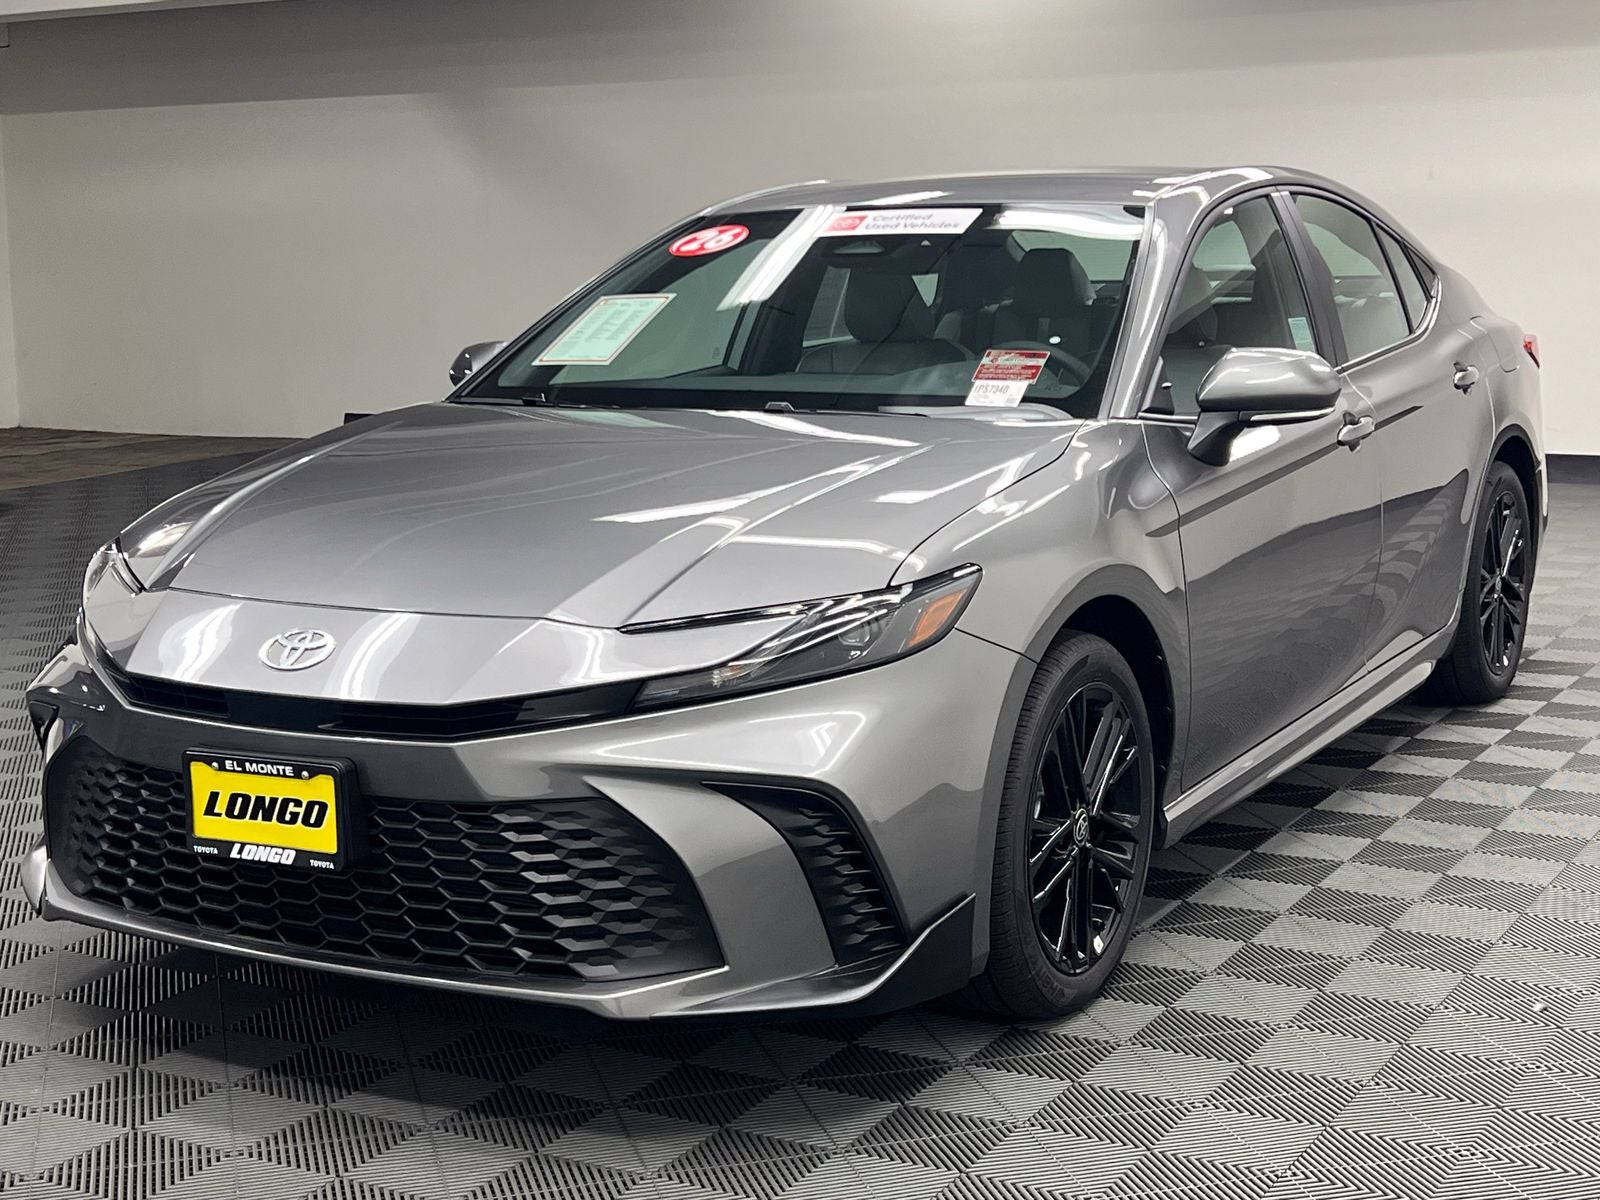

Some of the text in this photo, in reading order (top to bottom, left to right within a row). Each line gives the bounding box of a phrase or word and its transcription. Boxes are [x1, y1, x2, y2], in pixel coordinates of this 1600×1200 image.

[873, 213, 934, 222] Certified
[864, 220, 960, 231] Used Vehicles
[677, 227, 743, 252] 26
[225, 760, 295, 777] EL MONTE
[203, 790, 329, 829] LONGO
[193, 845, 219, 855] TOYOTA
[229, 842, 297, 865] LONGO
[309, 859, 335, 870] TOYOTA
